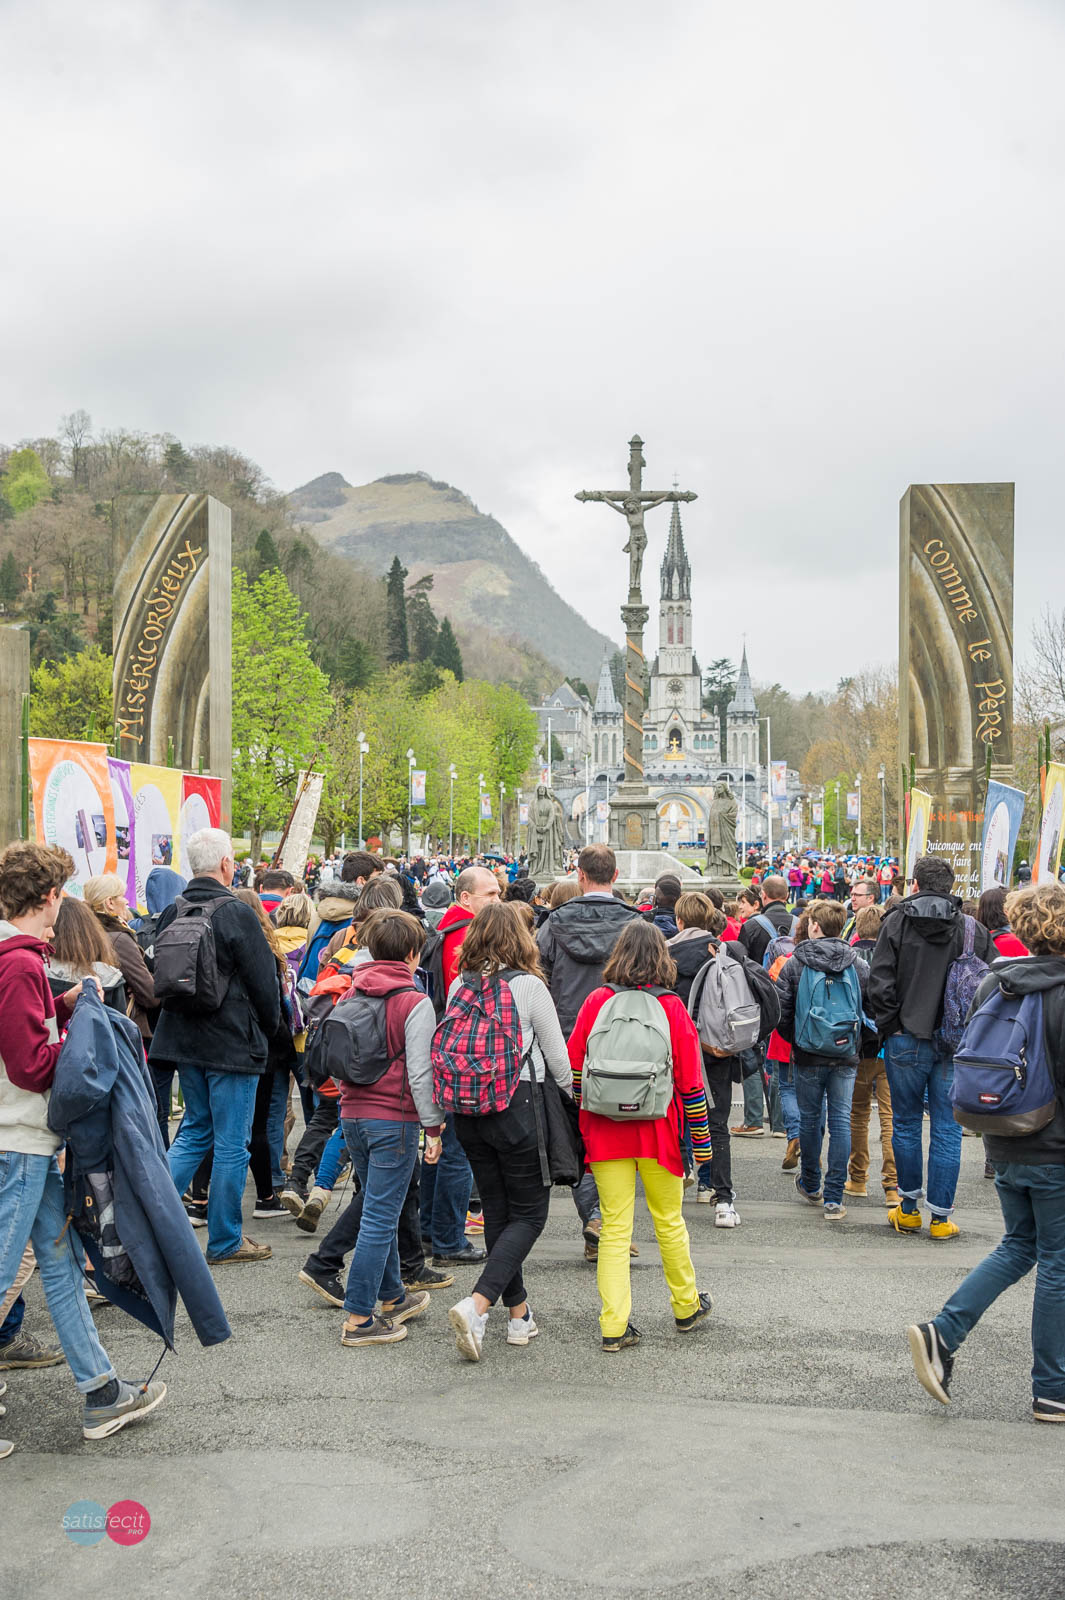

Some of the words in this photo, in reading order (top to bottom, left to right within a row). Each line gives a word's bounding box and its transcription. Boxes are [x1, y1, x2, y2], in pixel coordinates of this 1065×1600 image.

[967, 638, 992, 664] le
[926, 840, 965, 855] Quiconque
[952, 854, 971, 870] faire
[971, 869, 979, 882] de
[955, 885, 964, 897] de
